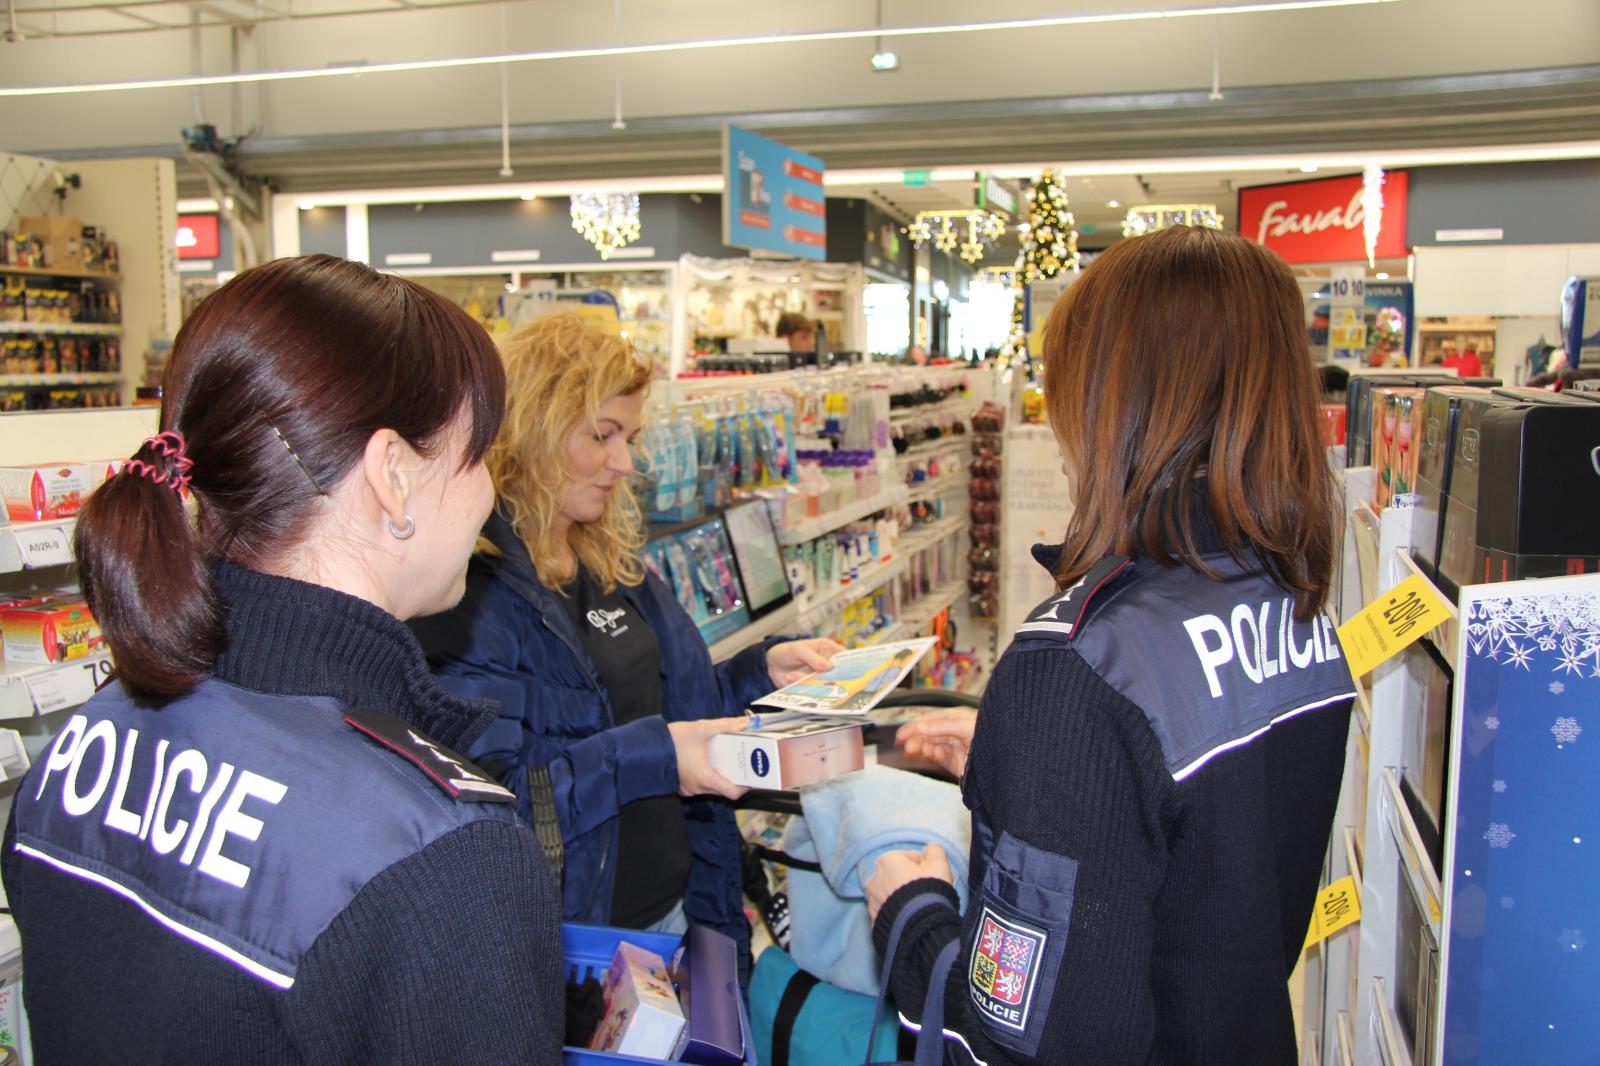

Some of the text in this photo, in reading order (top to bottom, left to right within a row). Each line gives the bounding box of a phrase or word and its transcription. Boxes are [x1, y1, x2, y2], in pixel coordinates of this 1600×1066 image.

[1333, 279, 1364, 296] 10 10
[1383, 591, 1429, 637] -20%
[1183, 598, 1340, 698] POLICIE
[36, 715, 288, 888] POLICIE
[972, 986, 1021, 1022] POLICIE
